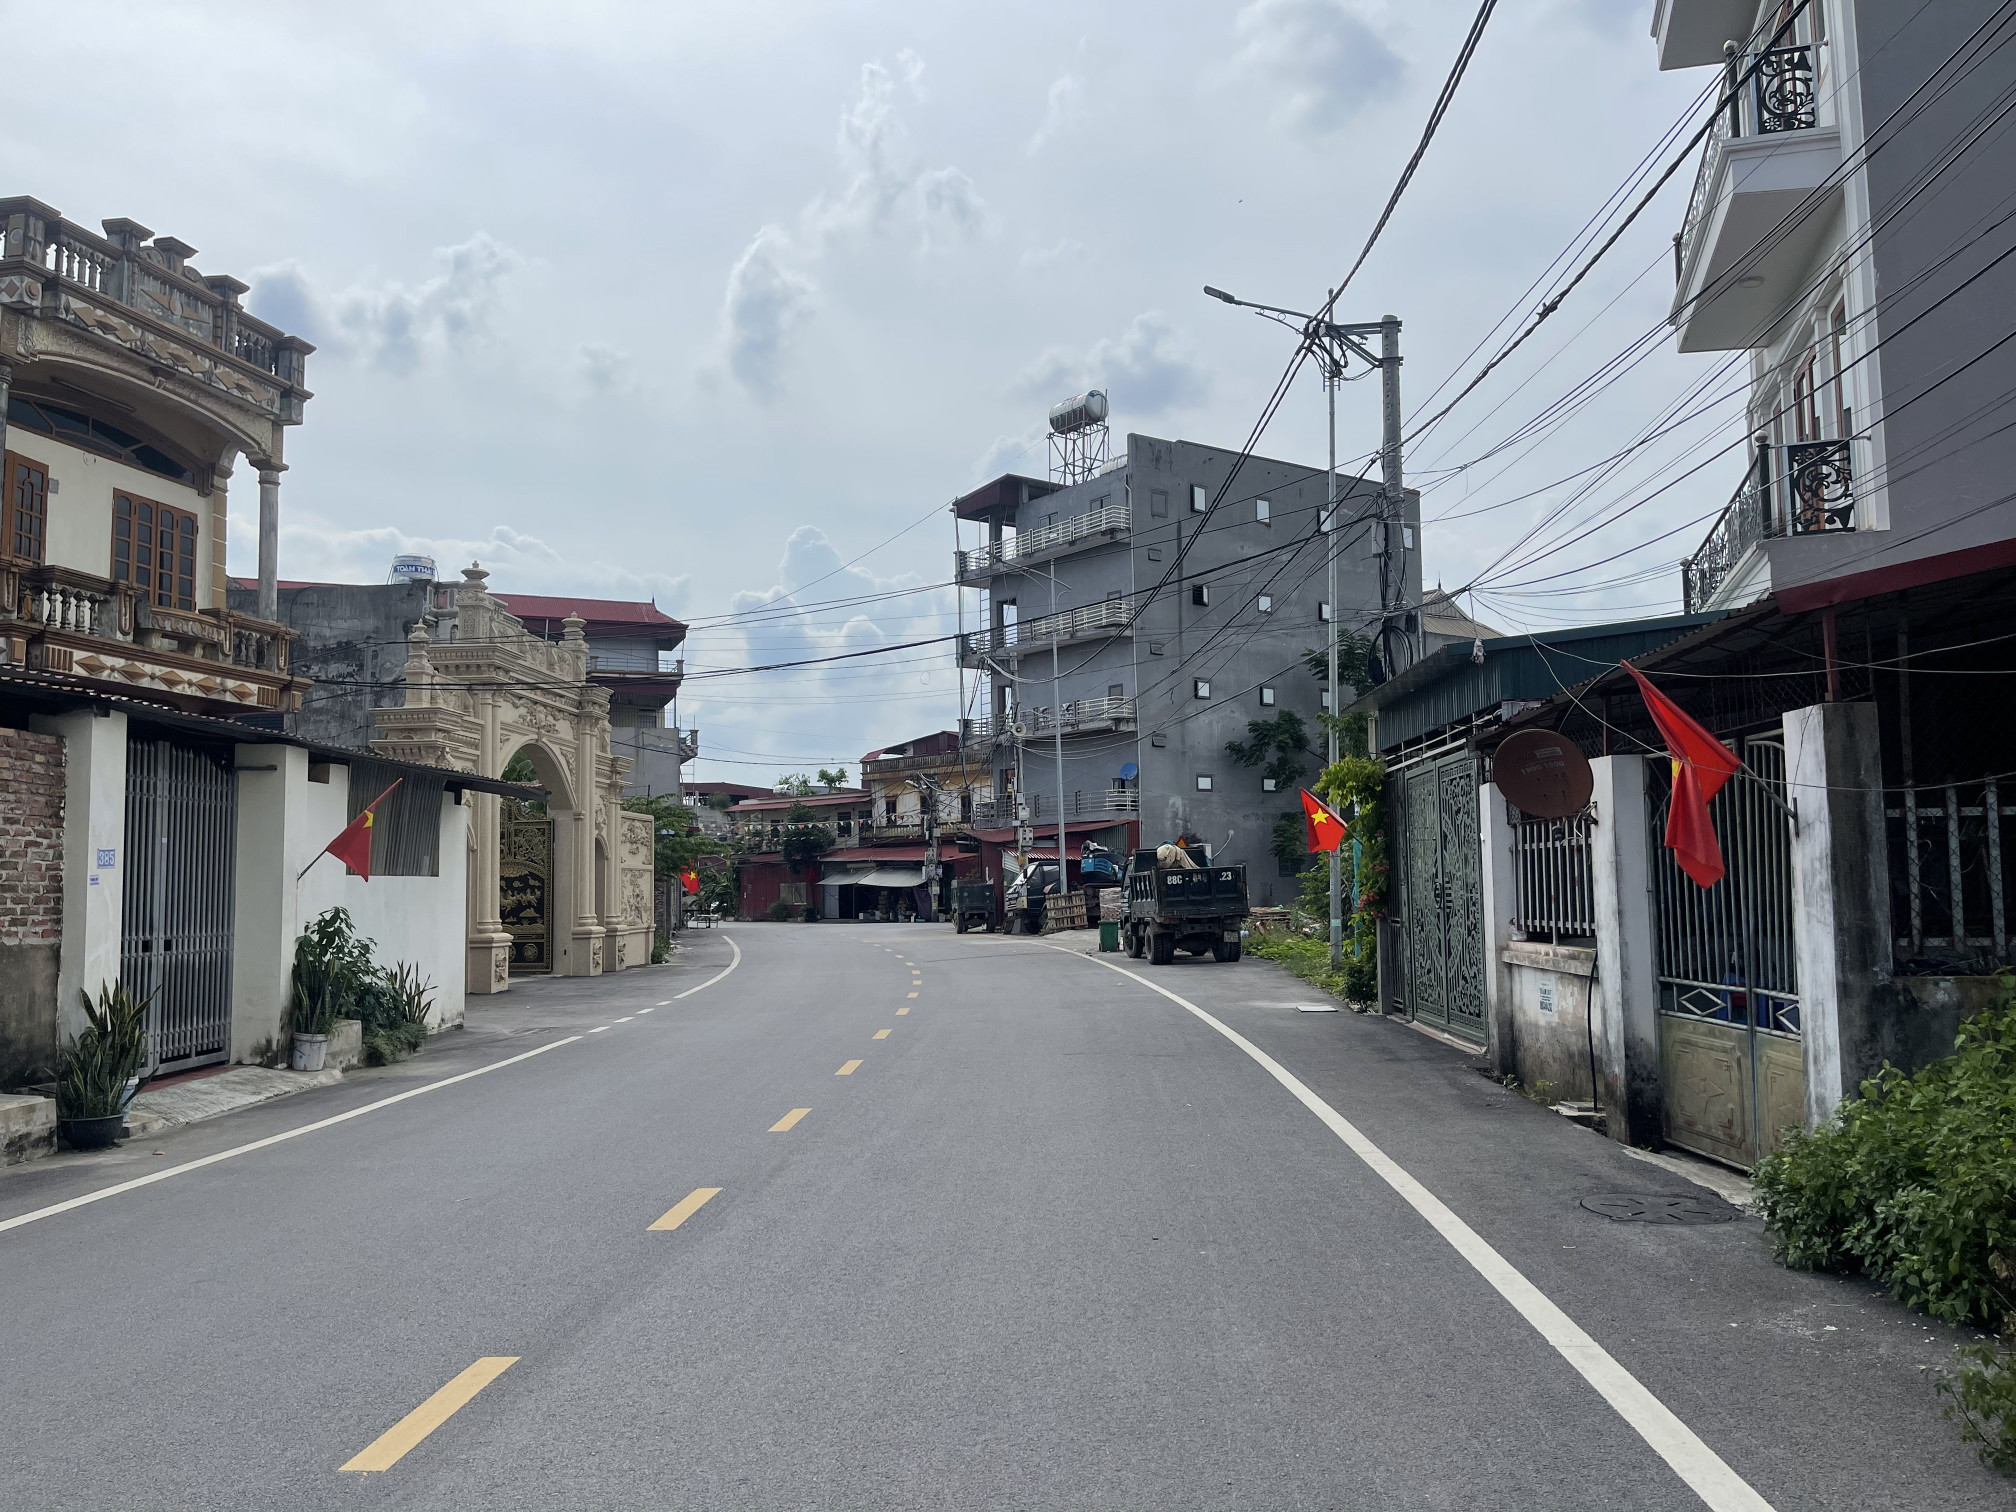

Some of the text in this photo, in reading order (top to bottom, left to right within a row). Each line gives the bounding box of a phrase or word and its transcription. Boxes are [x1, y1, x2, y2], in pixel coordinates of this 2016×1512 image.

[1544, 760, 1565, 768] 1900
[99, 851, 115, 865] 385
[1167, 875, 1183, 885] 88C
